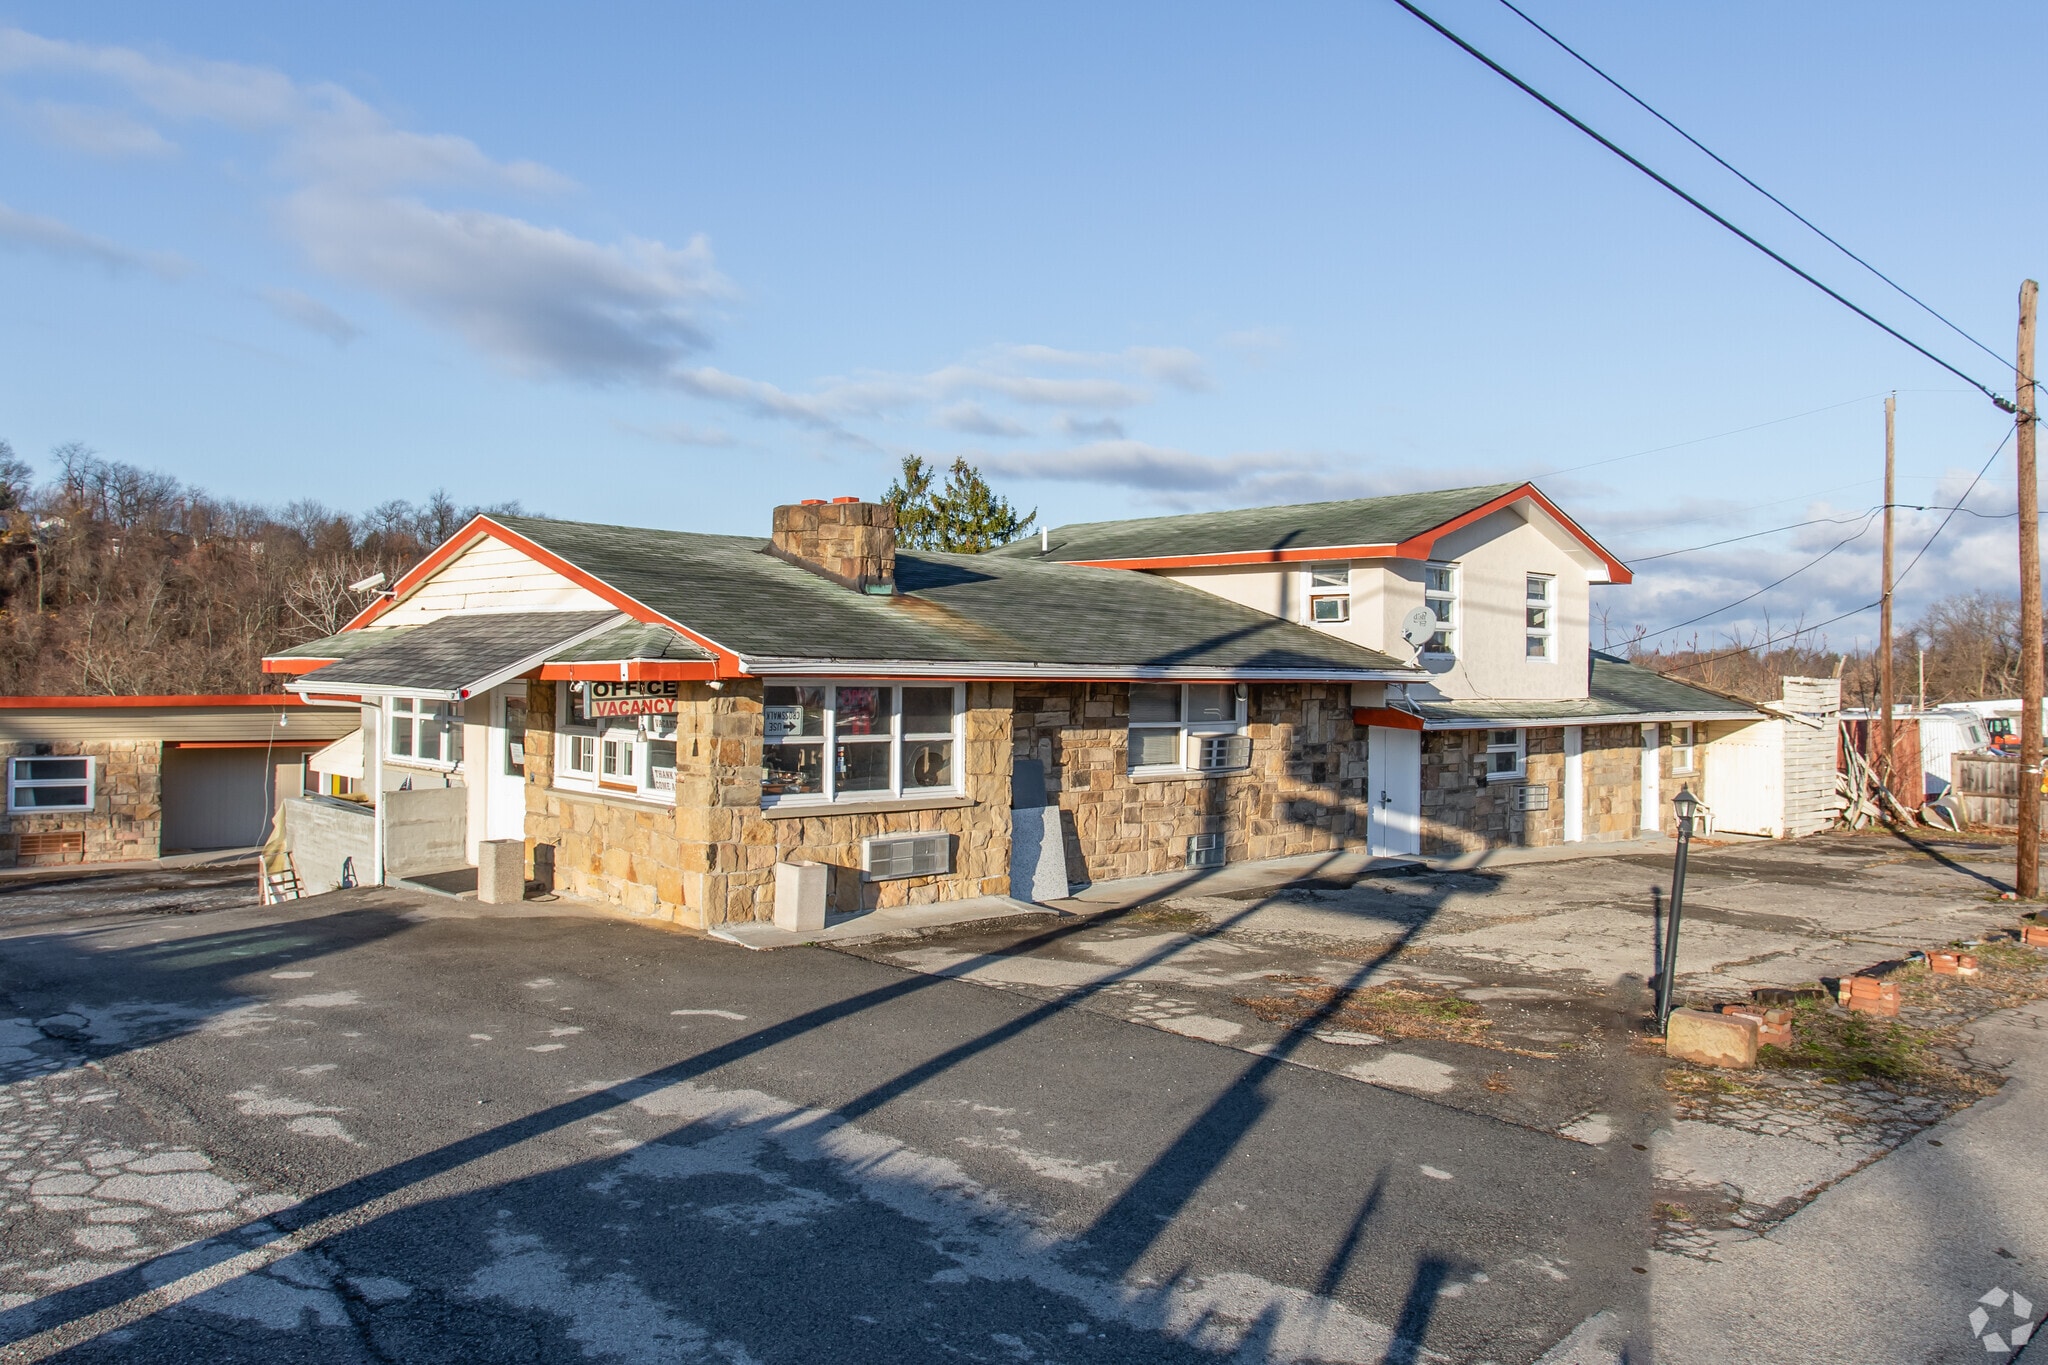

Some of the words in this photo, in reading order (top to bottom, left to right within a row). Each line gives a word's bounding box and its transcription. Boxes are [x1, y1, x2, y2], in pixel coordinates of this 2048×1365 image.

[593, 681, 677, 697] OFFICE
[841, 688, 871, 705] OPEN
[596, 698, 675, 717] VACANCY
[766, 711, 800, 720] CROSSWALK
[768, 722, 782, 732] USE
[654, 769, 674, 780] THANK
[656, 781, 671, 791] COME
